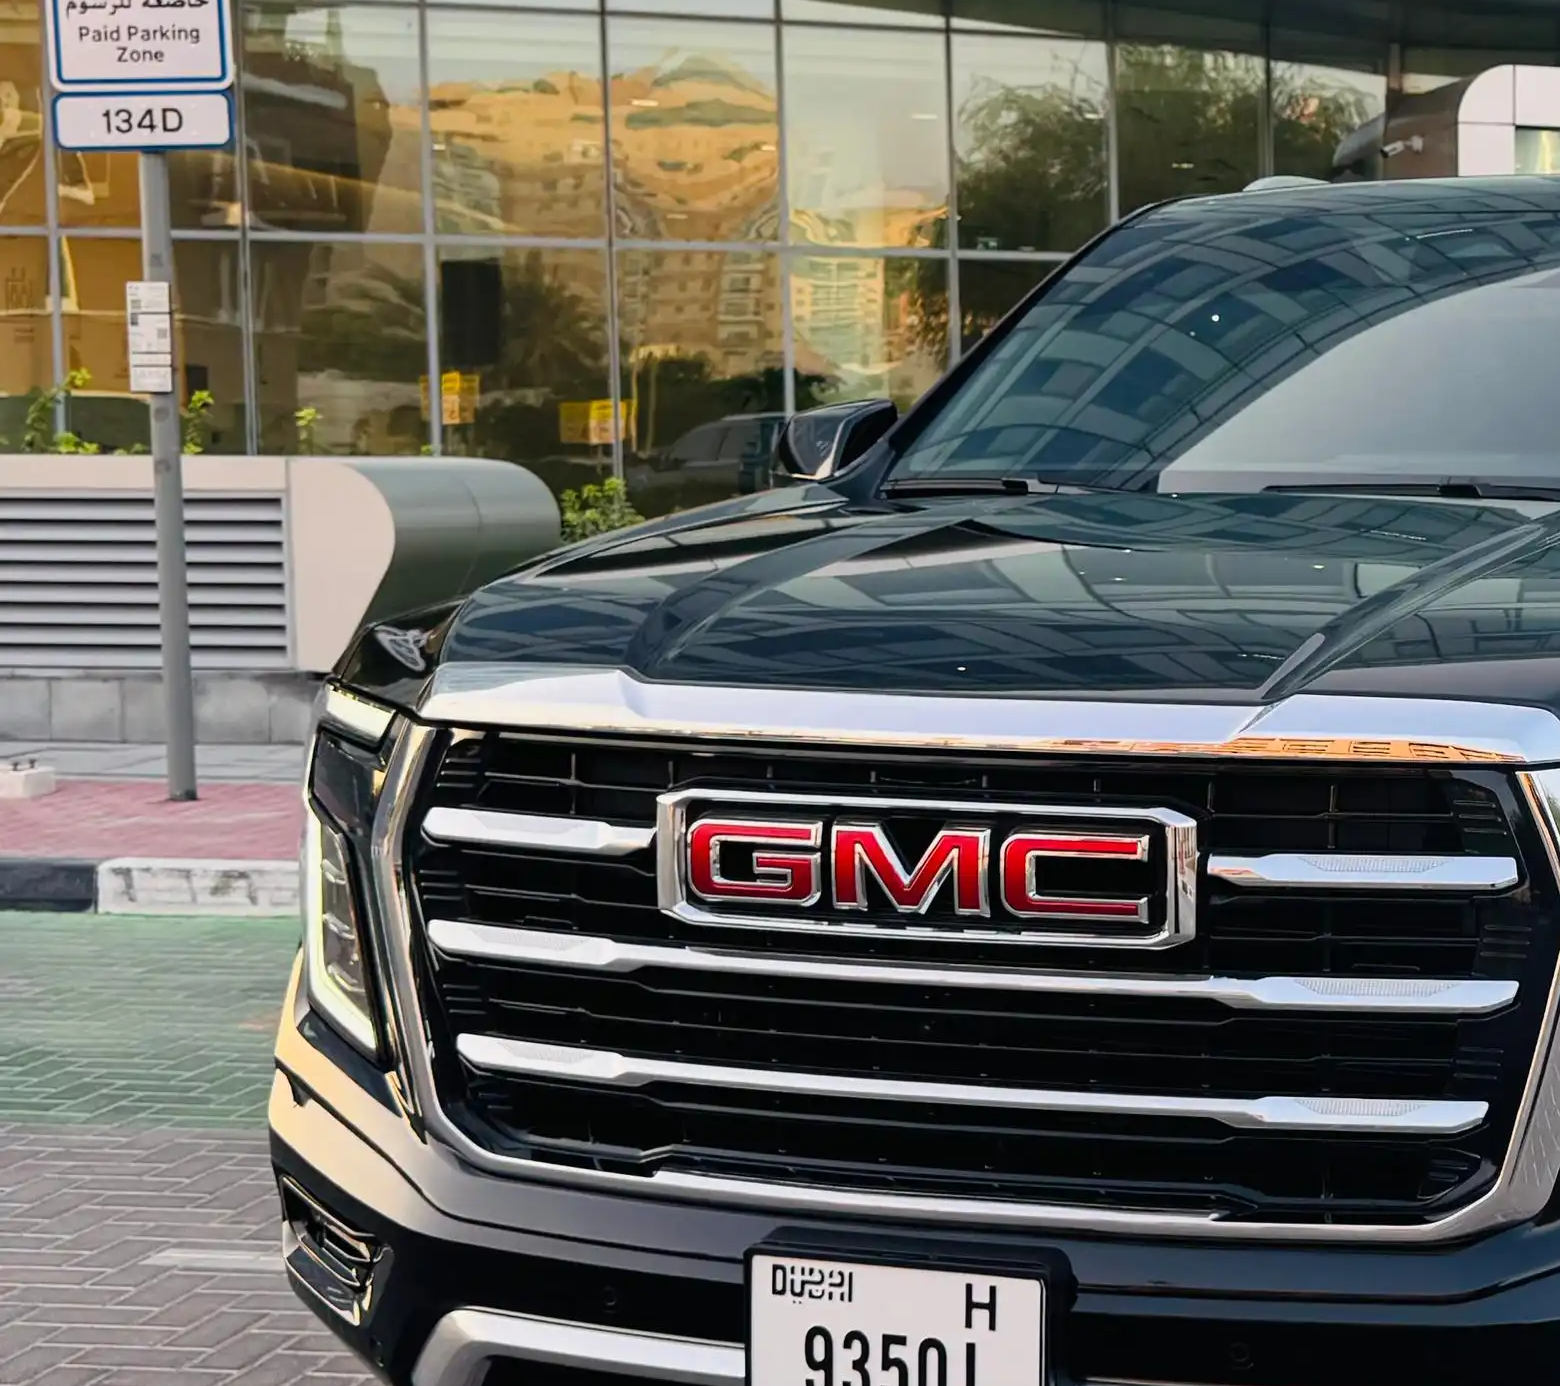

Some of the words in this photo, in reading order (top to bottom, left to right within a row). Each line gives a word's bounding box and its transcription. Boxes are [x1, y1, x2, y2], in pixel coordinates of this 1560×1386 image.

[78, 25, 121, 43] Paid
[127, 23, 201, 45] Parking
[116, 46, 165, 63] Zone
[101, 107, 184, 135] 134D
[686, 816, 1150, 924] GMC
[964, 1282, 997, 1332] H
